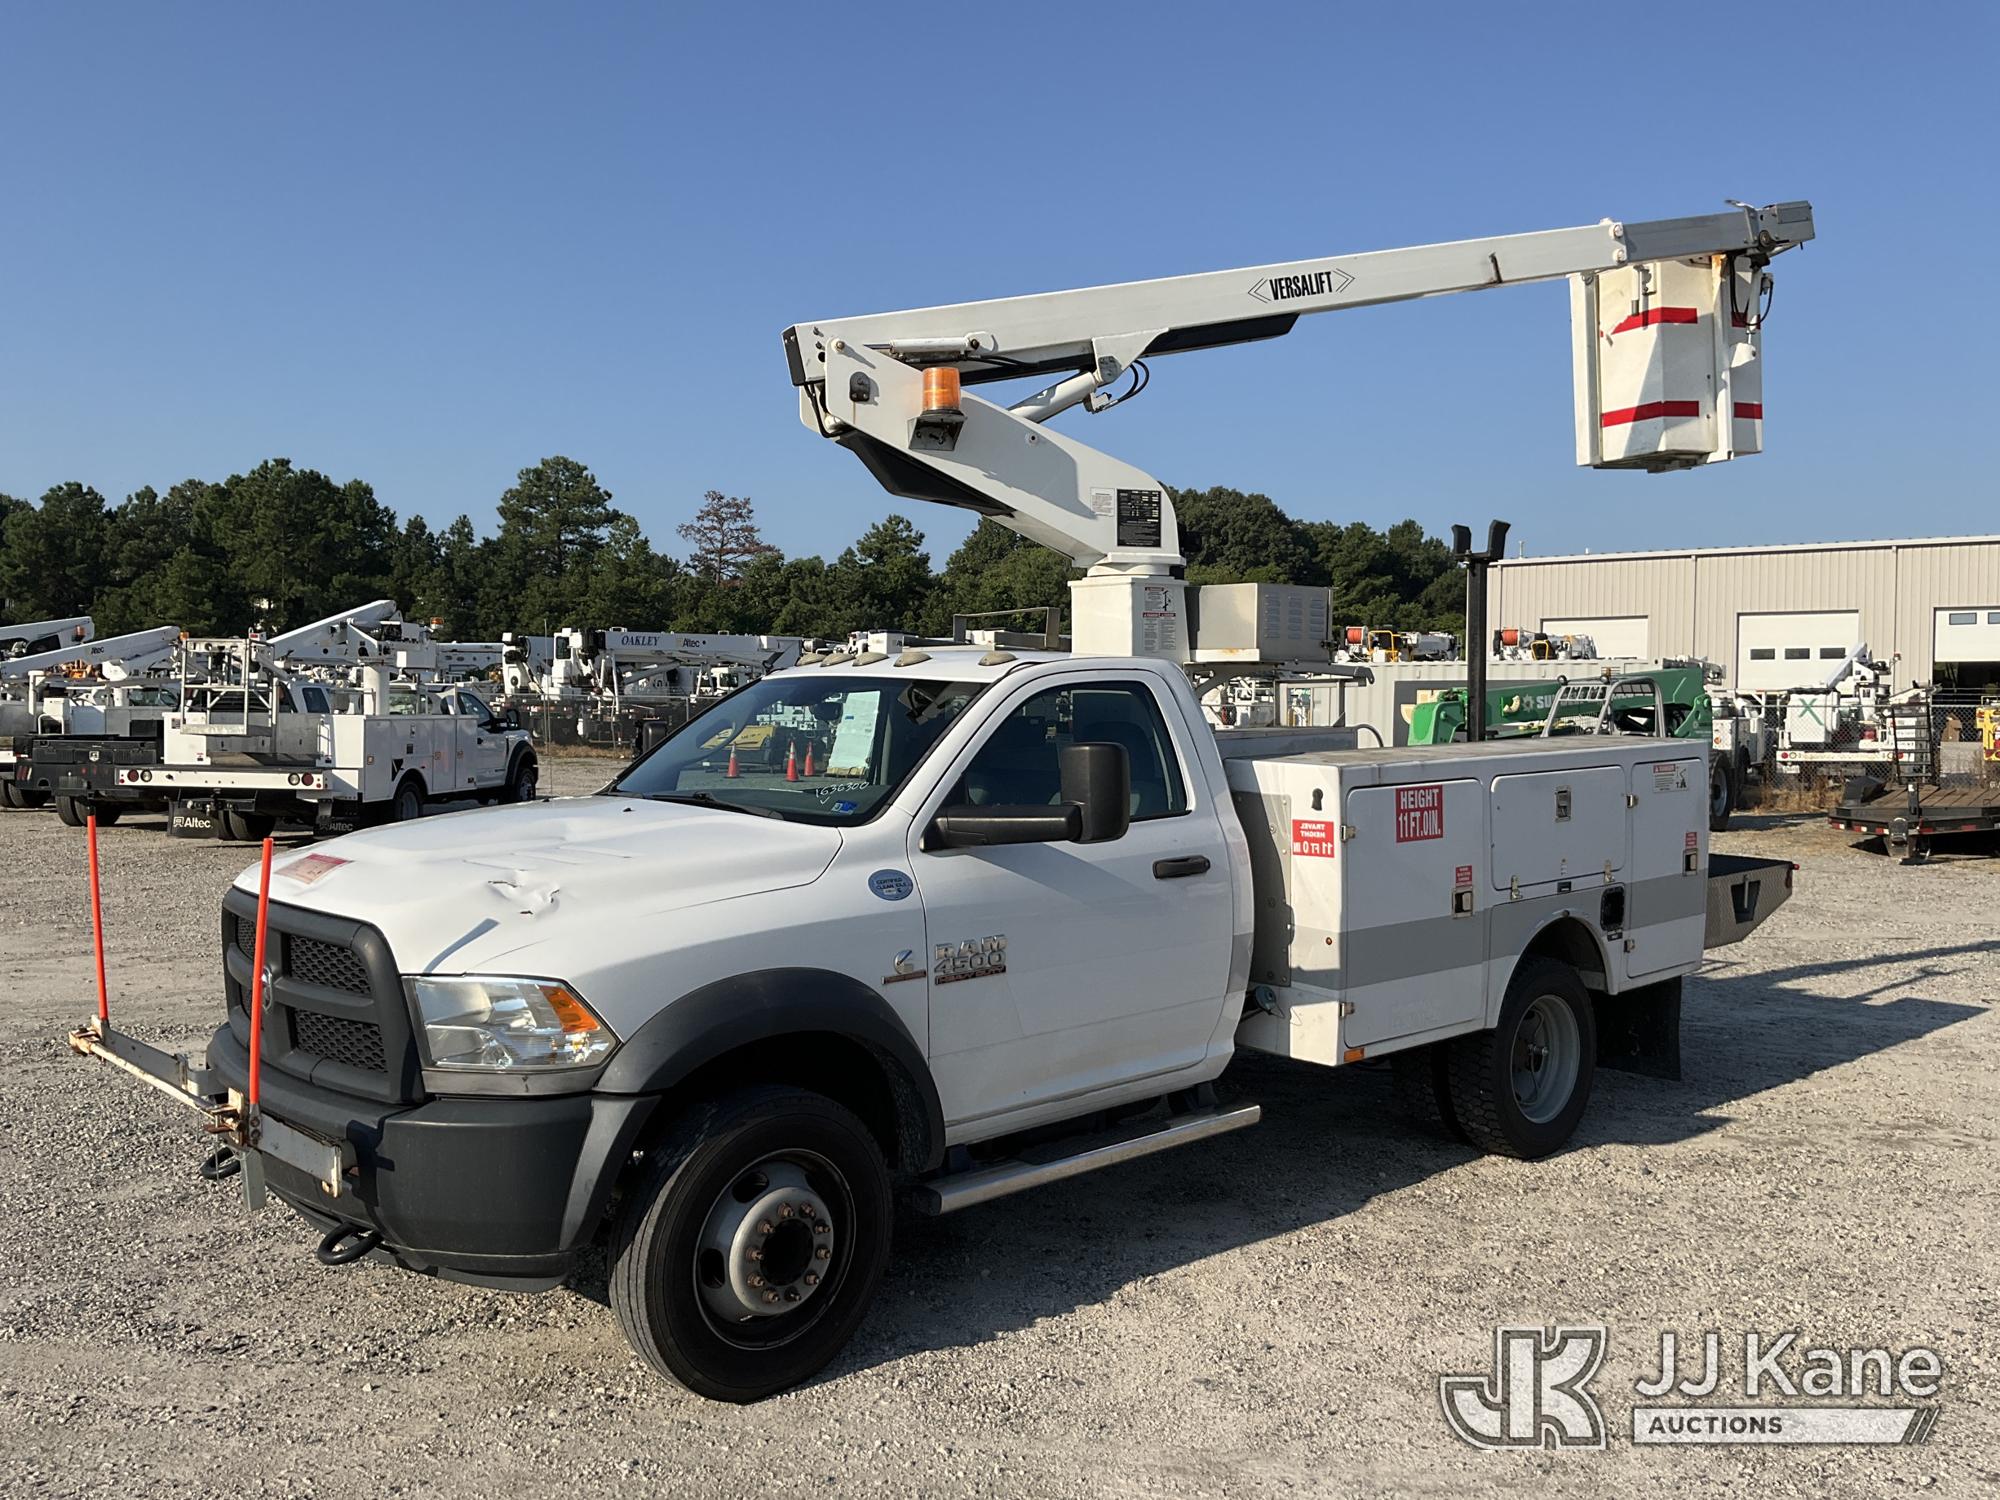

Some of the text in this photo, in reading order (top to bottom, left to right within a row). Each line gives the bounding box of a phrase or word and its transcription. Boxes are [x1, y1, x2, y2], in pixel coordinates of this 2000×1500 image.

[1269, 271, 1332, 300] VERSALIFT
[621, 635, 660, 646] OAKLEY
[1400, 788, 1440, 810] HEIGHT
[184, 816, 211, 829] Altec
[329, 822, 354, 832] Altec
[935, 934, 1007, 960] RAM
[934, 949, 1006, 974] 4500
